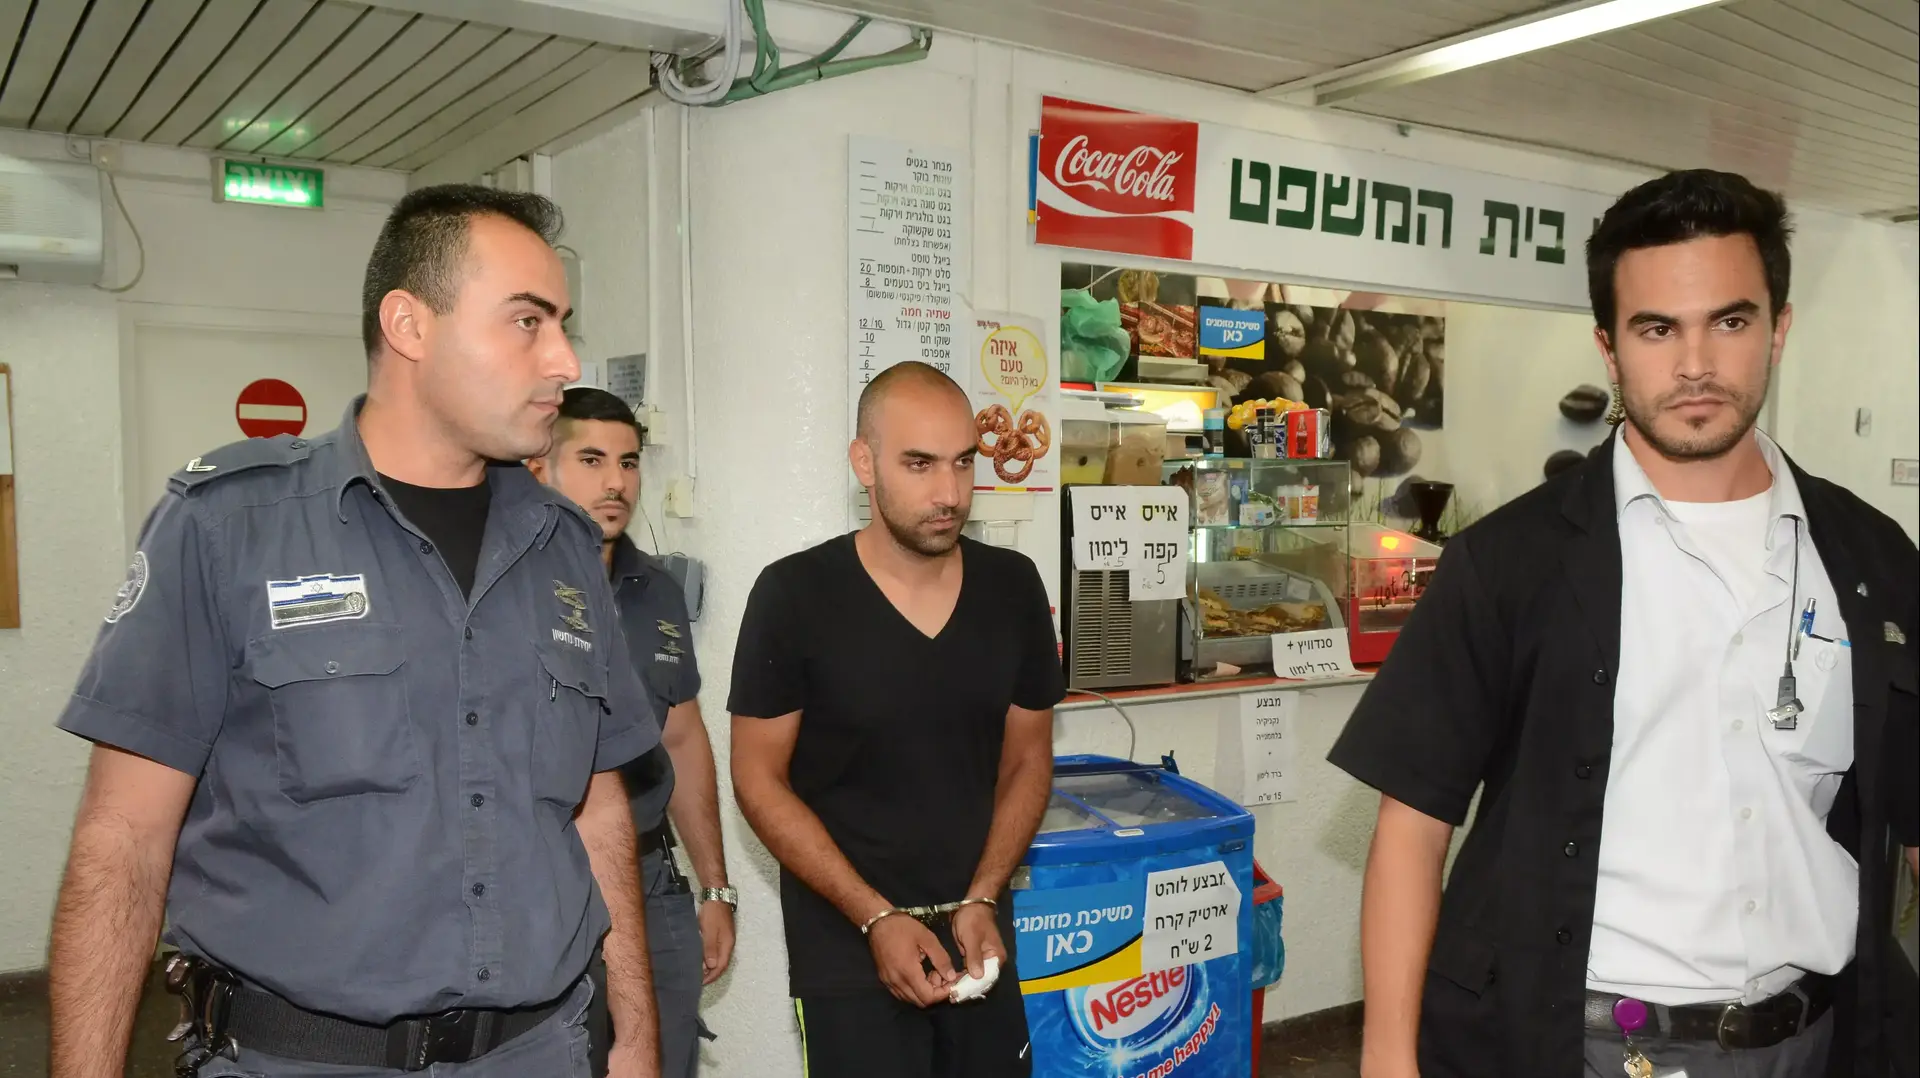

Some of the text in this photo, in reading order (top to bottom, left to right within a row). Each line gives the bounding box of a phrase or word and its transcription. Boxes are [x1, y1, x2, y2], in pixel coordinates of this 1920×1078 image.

[906, 157, 952, 172] מבחר בגטים
[1055, 135, 1183, 201] Coca-Cola
[913, 171, 929, 182] בוקר
[885, 181, 907, 193] וירקות
[938, 188, 951, 198] בגט
[901, 197, 917, 207] ביצה
[921, 200, 936, 209] טונה
[939, 202, 951, 211] בגט
[880, 207, 951, 224] בגט בולגרית וירקות
[1229, 158, 1565, 264] בית המשפט
[903, 224, 951, 238] בגט שקשוקה
[894, 236, 919, 247] בצלחת)
[912, 253, 950, 265] בייגל טוסט
[877, 263, 905, 274] תוספות
[912, 266, 931, 278] ירקות
[935, 268, 950, 279] סלט
[865, 277, 870, 286] 8
[884, 278, 950, 292] בייגל ביס בטעמים
[901, 307, 950, 319] שתיה חמה
[935, 322, 950, 334] הפוך
[1205, 318, 1260, 331] משיכת מזומנים
[865, 333, 875, 341] 10
[920, 335, 950, 346] שוקו חם
[1223, 329, 1243, 343] כאן
[865, 346, 870, 354] 7
[921, 348, 950, 358] אספרסו
[990, 339, 1017, 357] איזה
[864, 360, 870, 368] 6
[1000, 359, 1023, 373] טעם
[1029, 378, 1039, 387] בא
[1090, 505, 1126, 520] אייס
[1142, 505, 1178, 521] אייס
[1089, 538, 1128, 561] לימון
[1144, 542, 1177, 563] קפה
[1298, 638, 1333, 654] סנדוויץ
[1317, 662, 1340, 672] ברד
[1256, 697, 1281, 708] מבצע
[1271, 770, 1282, 778] ברד
[1259, 792, 1281, 802] 15 ש"ח
[1155, 872, 1226, 896] מבצע לוהט
[1012, 904, 1133, 933] משיכת מזומני
[1155, 904, 1228, 930] ארטיק קרח
[1046, 930, 1094, 963] כאן
[1170, 934, 1213, 959] 2 ש"ח
[1174, 1002, 1221, 1066] happy!
